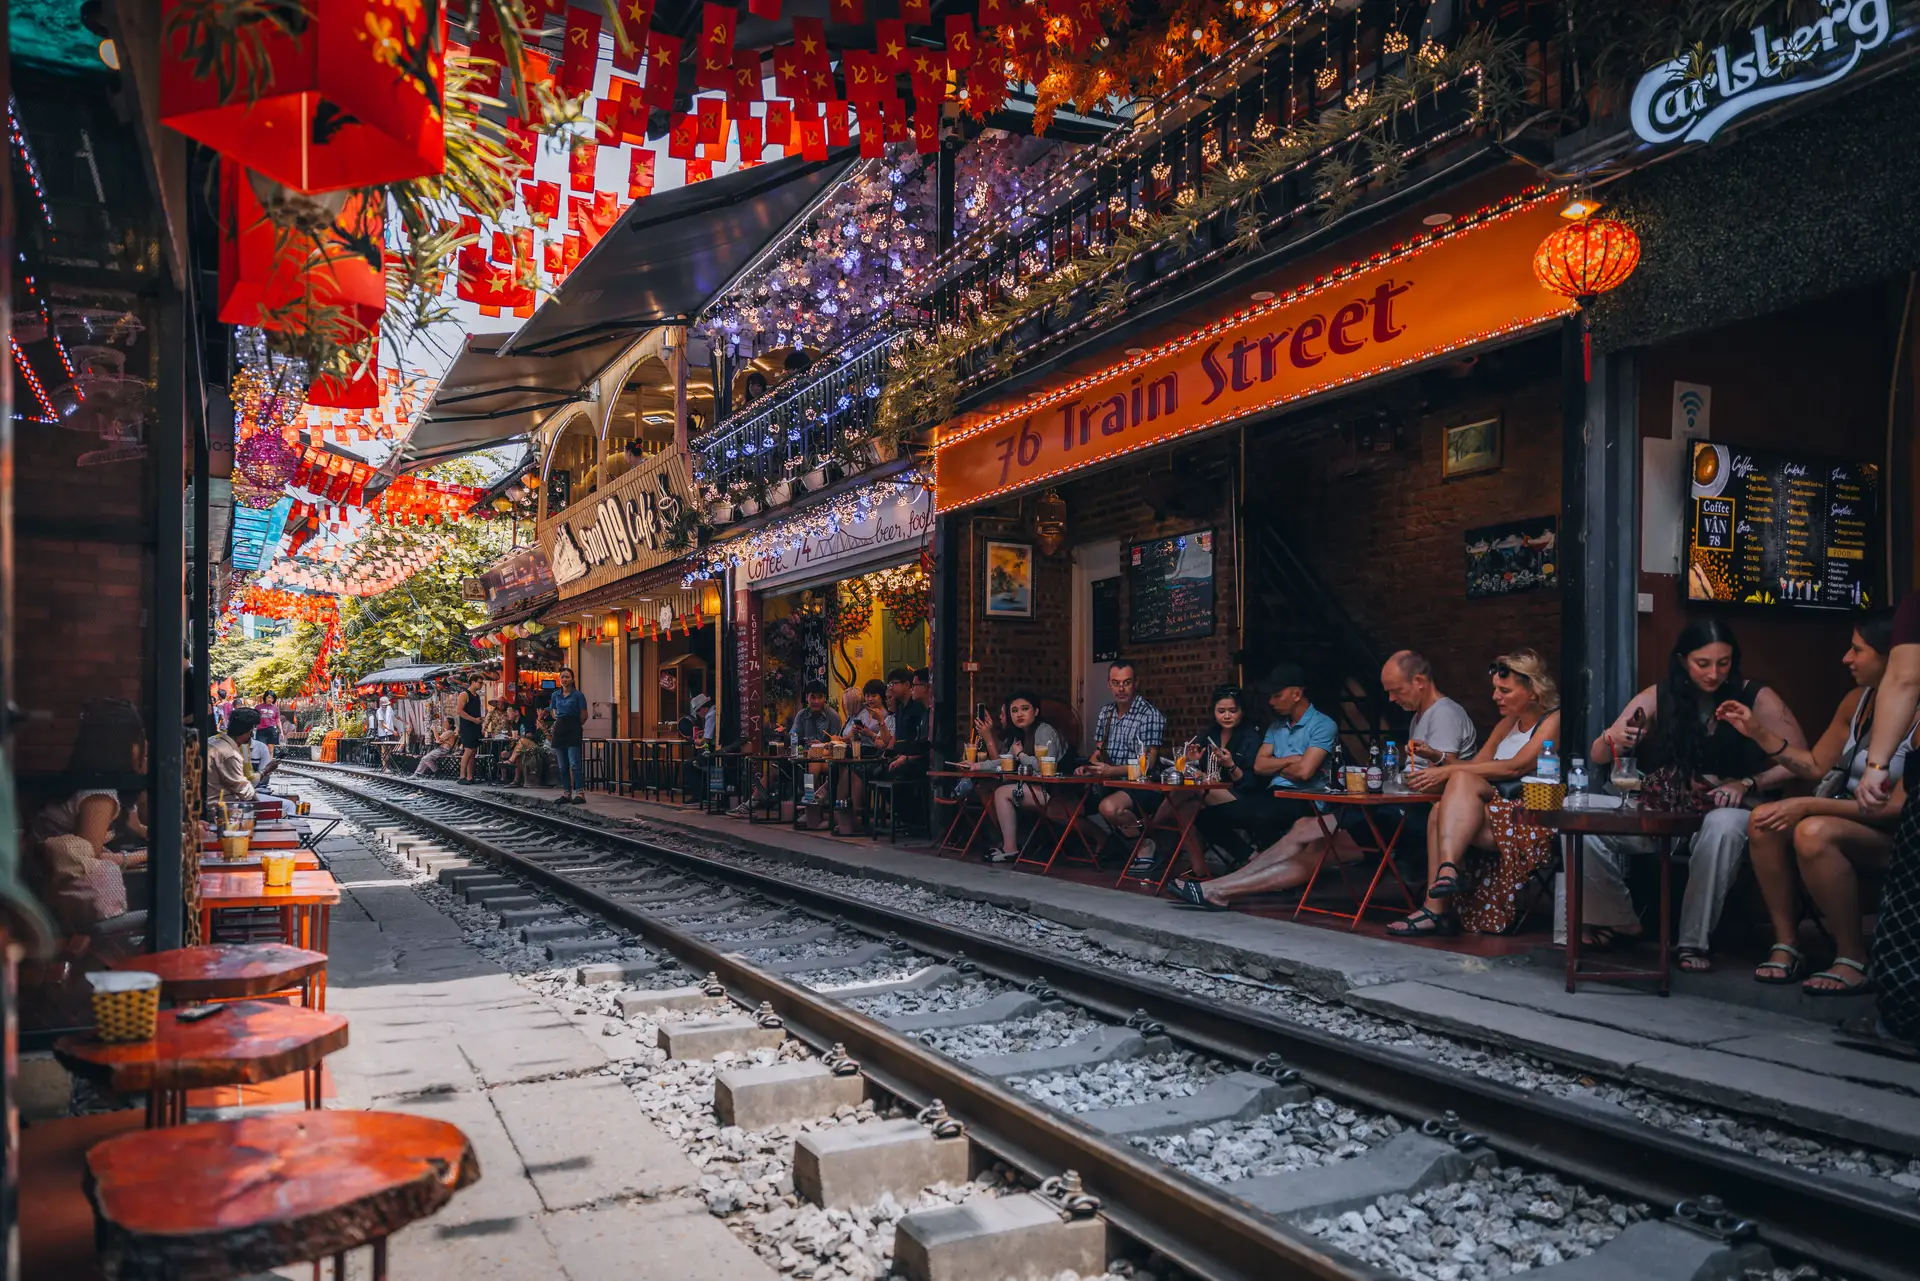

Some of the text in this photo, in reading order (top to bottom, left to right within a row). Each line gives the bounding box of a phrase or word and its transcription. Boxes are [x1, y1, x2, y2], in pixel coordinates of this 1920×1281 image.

[1630, 0, 1891, 144] Carlsberg
[995, 279, 1414, 486] 76 Train Street
[1703, 500, 1730, 514] Coffee
[597, 497, 633, 566] 09
[626, 491, 657, 551] Café
[1704, 515, 1727, 534] VÂN
[1709, 535, 1721, 547] 78
[749, 660, 760, 672] 74
